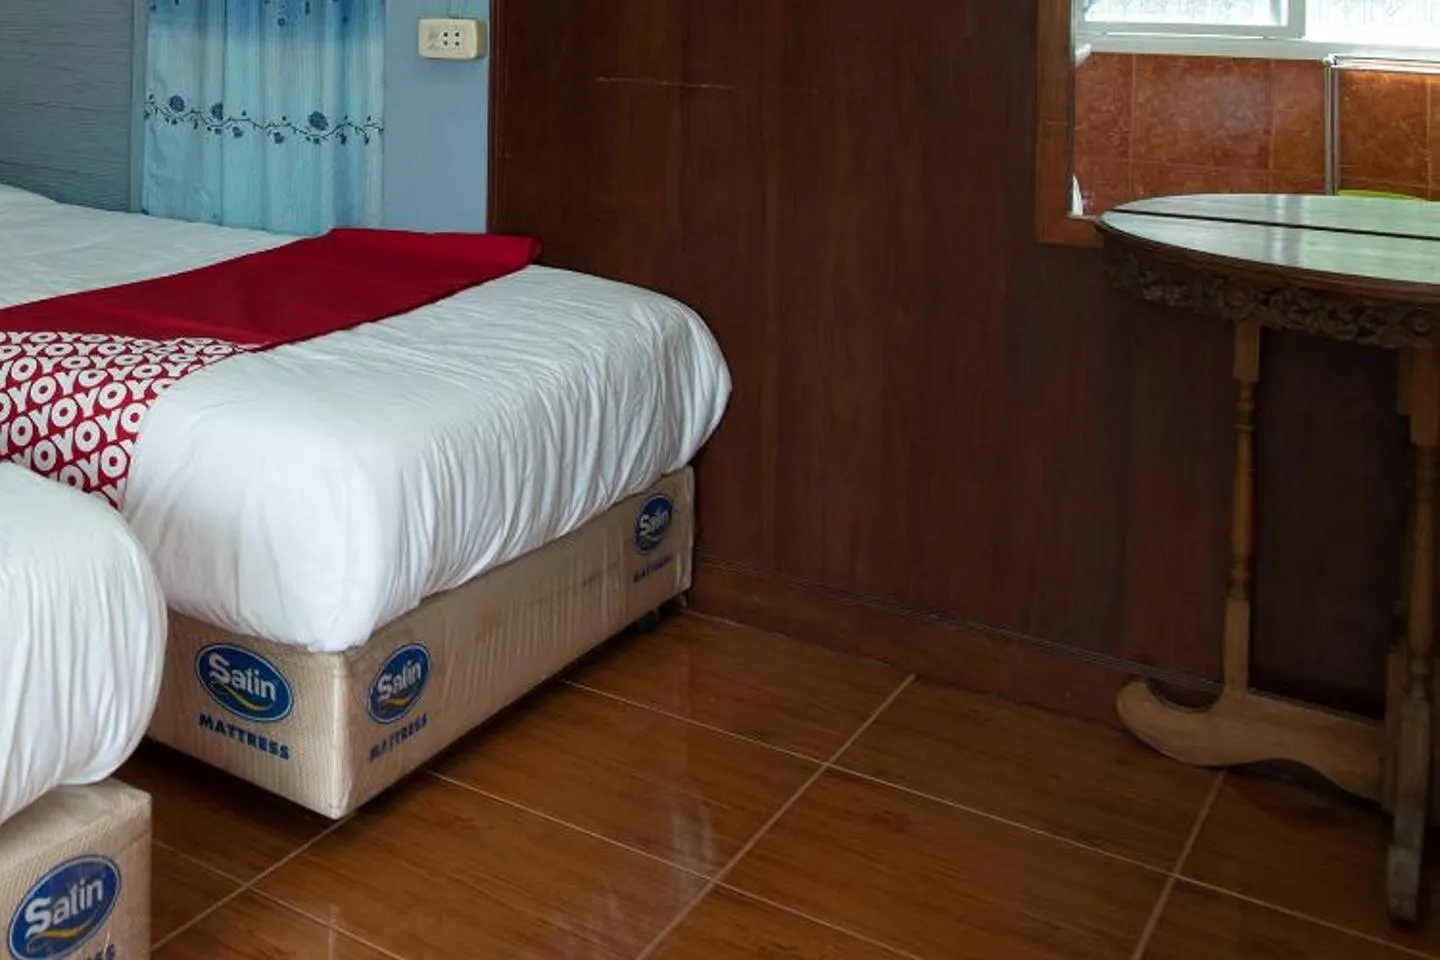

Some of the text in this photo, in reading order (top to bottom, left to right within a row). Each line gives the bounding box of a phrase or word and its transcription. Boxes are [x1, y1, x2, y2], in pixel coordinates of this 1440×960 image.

[208, 652, 276, 702] Satin
[199, 713, 290, 761] MATTRESS
[25, 878, 103, 940] Satin
